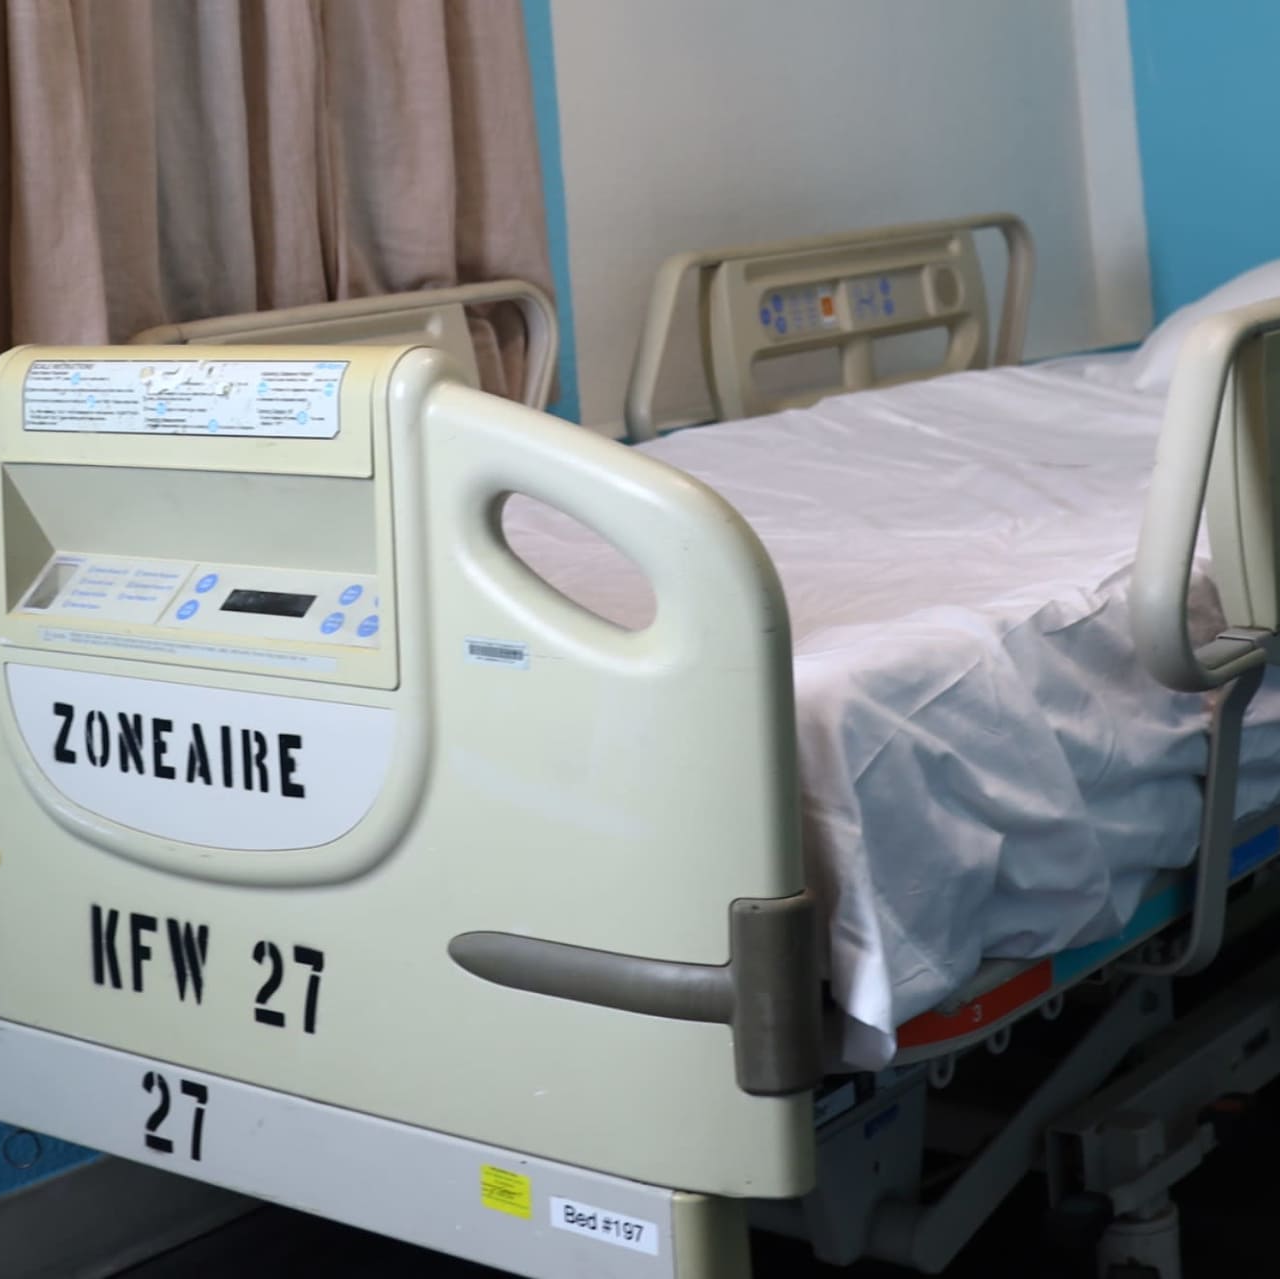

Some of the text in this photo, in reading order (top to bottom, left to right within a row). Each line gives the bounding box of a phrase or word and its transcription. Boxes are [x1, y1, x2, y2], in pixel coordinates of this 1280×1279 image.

[53, 702, 305, 798] ZONEAIRE
[91, 904, 324, 1034] KFW 27
[142, 1071, 208, 1161] 27
[564, 1204, 644, 1242] Bed #197
